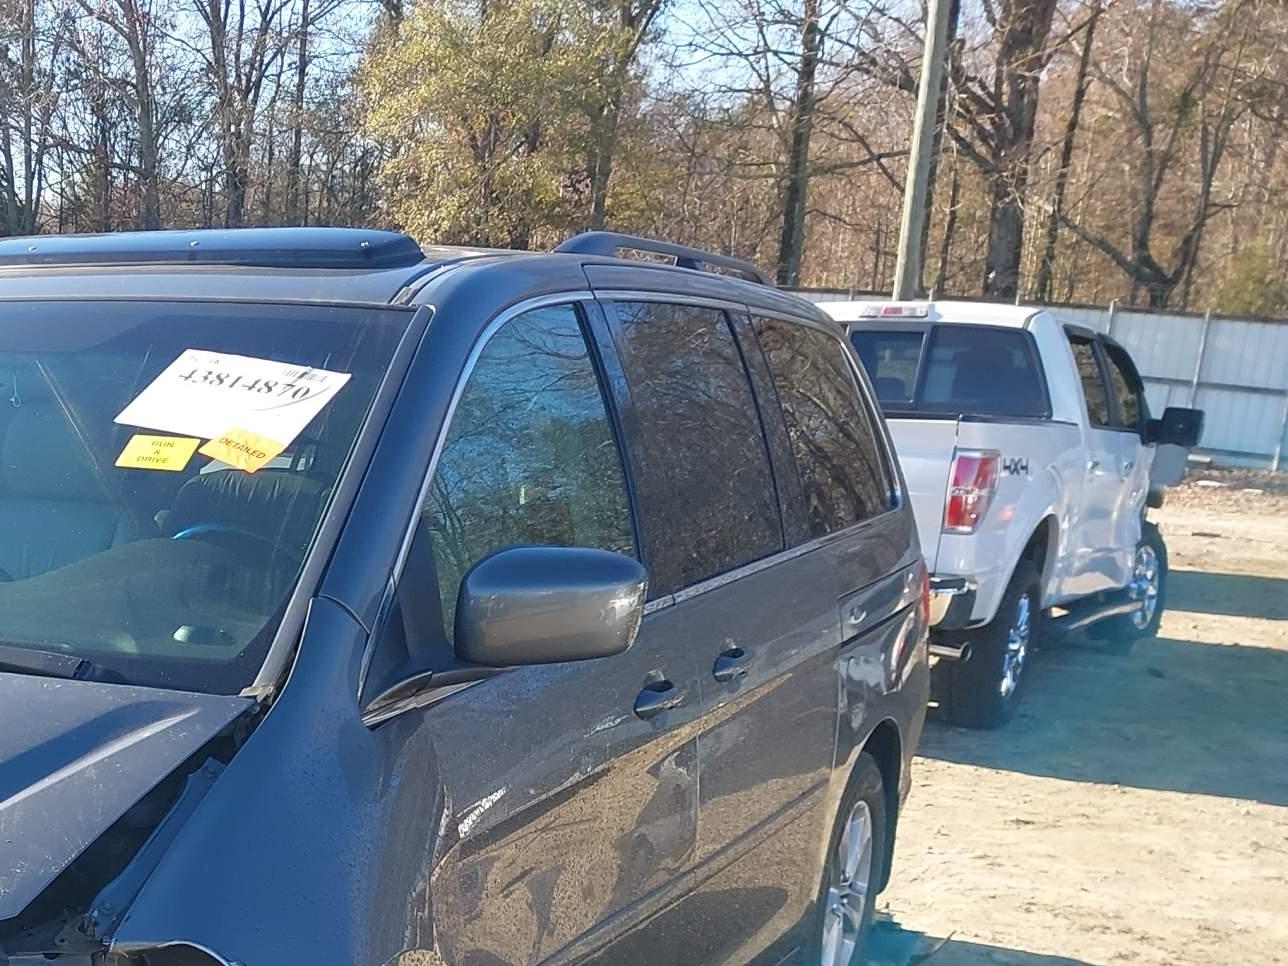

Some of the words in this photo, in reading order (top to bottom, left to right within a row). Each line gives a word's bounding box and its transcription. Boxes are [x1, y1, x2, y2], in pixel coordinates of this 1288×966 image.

[178, 369, 311, 399] 43814870
[136, 455, 169, 464] DRIVE
[218, 436, 267, 460] DETAILED
